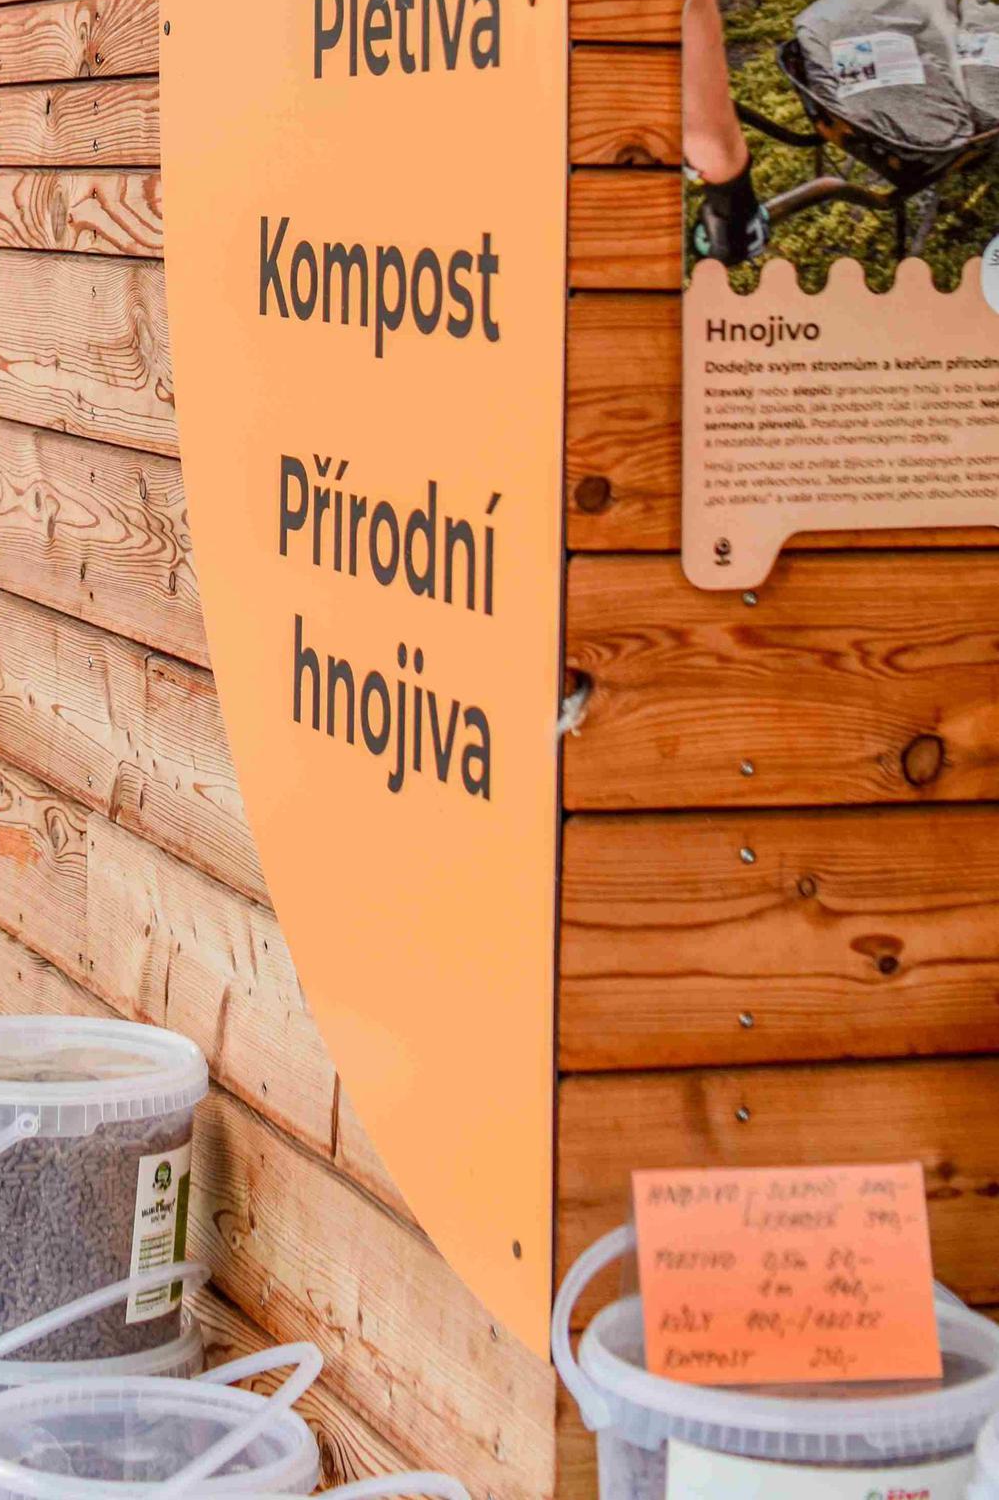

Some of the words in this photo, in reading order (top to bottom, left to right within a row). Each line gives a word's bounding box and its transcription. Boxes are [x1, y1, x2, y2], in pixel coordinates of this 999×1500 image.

[258, 214, 500, 359] Kompost
[706, 315, 821, 348] Hnojivo
[278, 453, 502, 617] Přírodní
[292, 612, 491, 802] hnojiva
